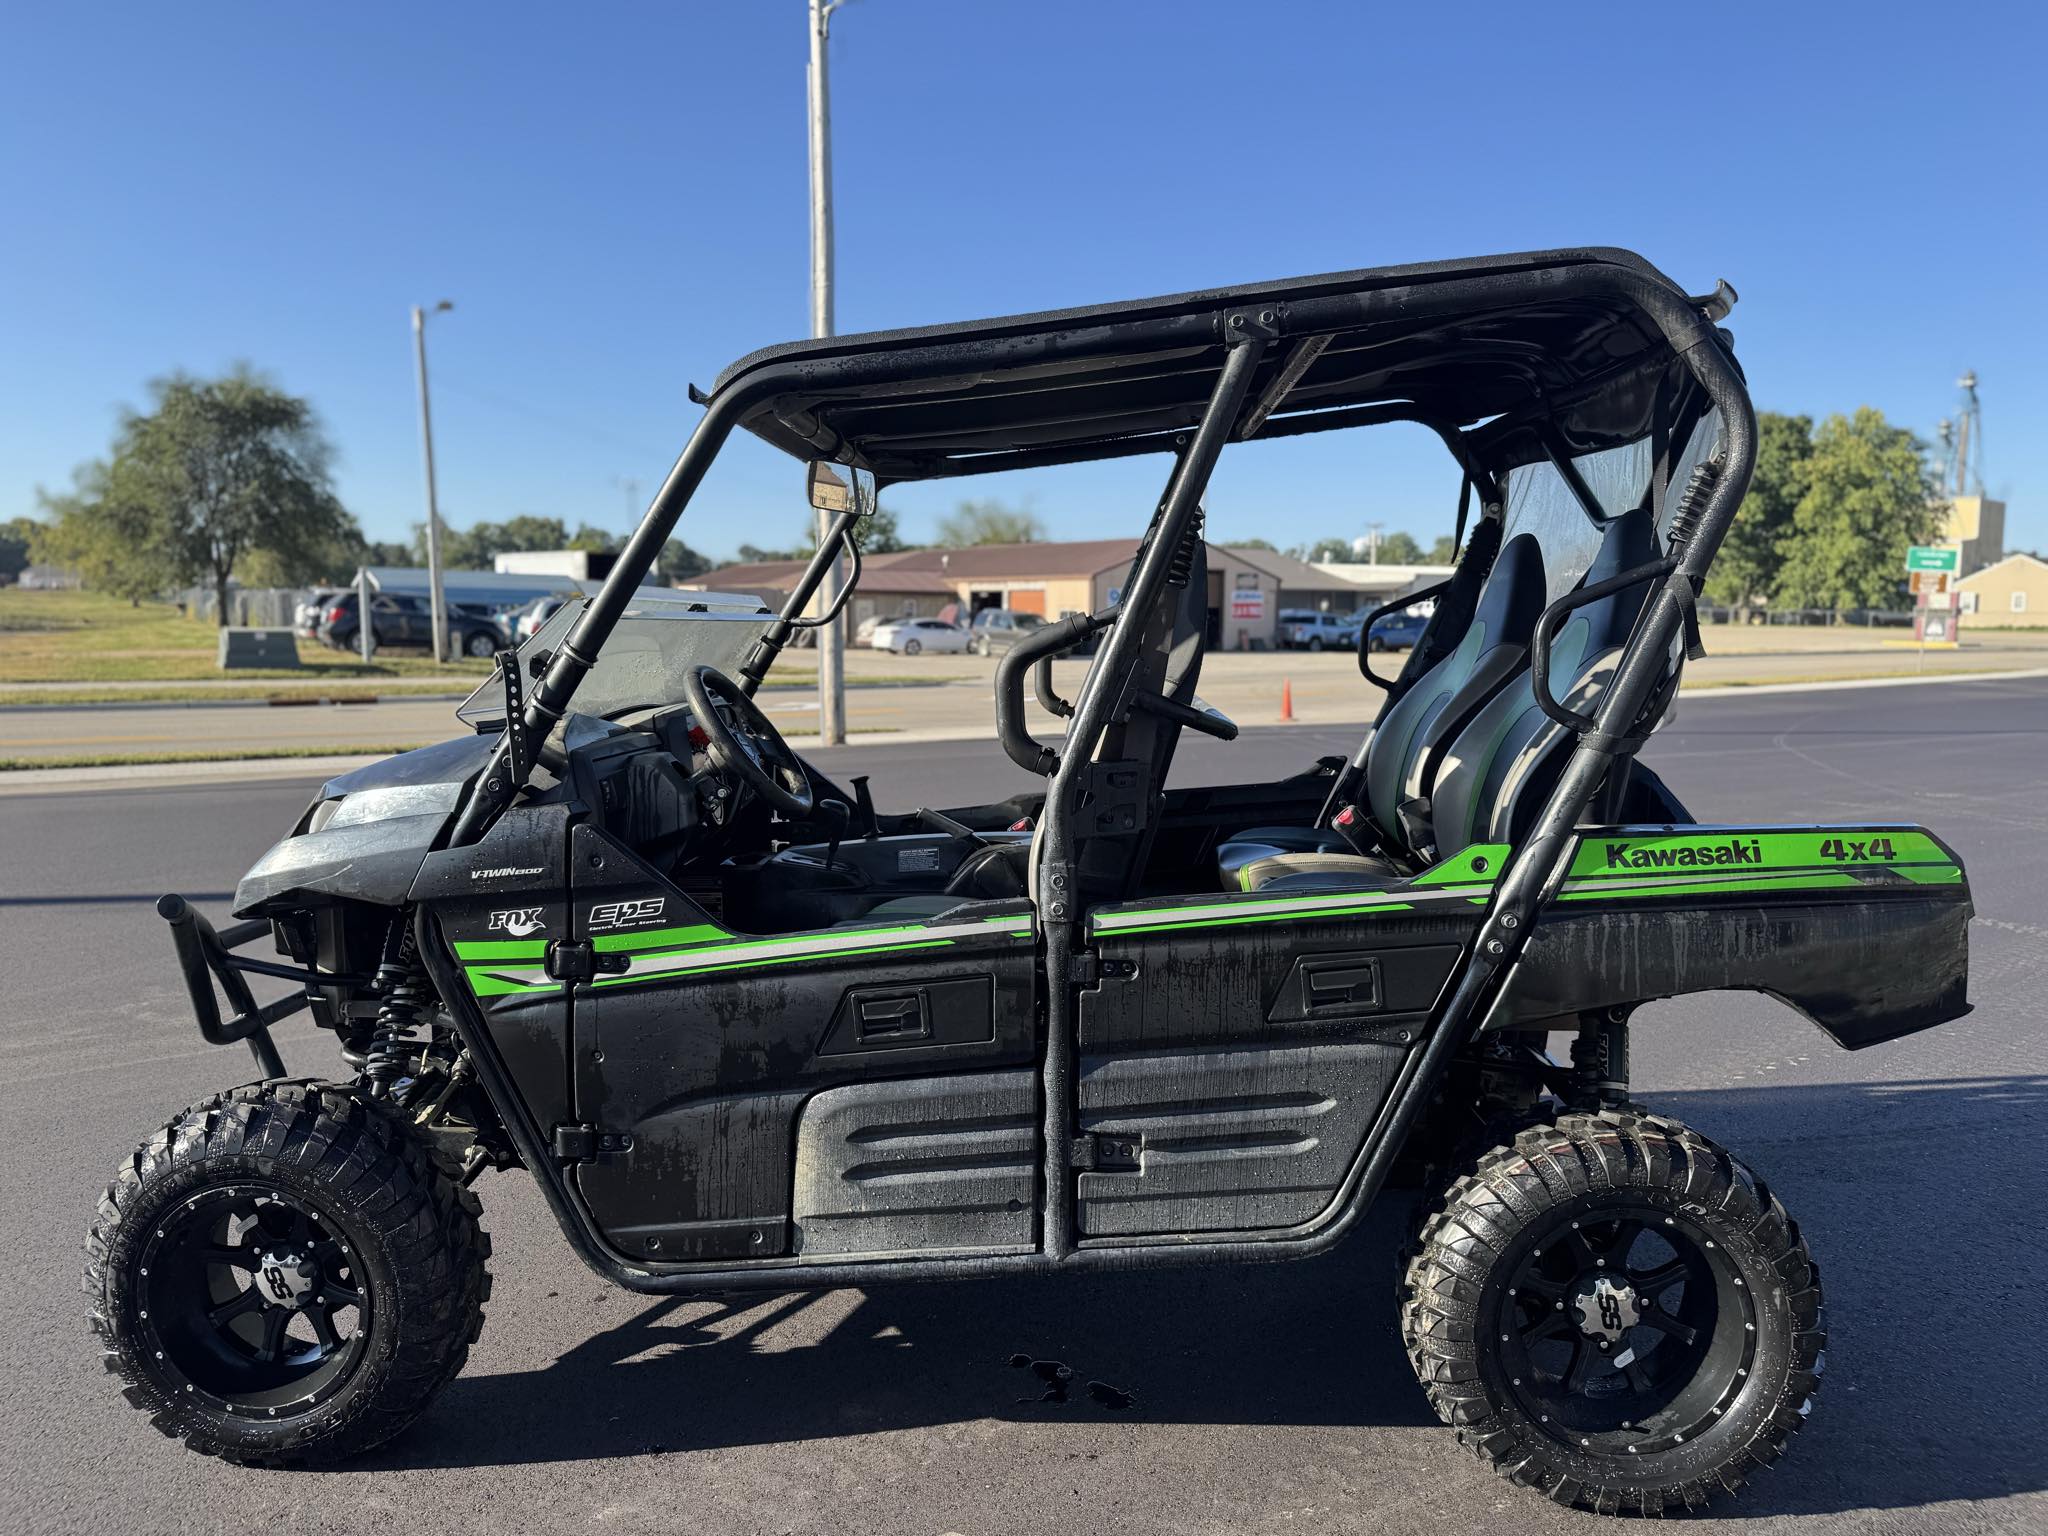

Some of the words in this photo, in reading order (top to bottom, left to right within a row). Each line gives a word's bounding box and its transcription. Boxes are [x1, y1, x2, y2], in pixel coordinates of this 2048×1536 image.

[1605, 839, 1761, 869] Kawasaki
[1819, 838, 1897, 861] 4x4
[488, 906, 544, 932] FOX
[588, 897, 665, 925] EPS
